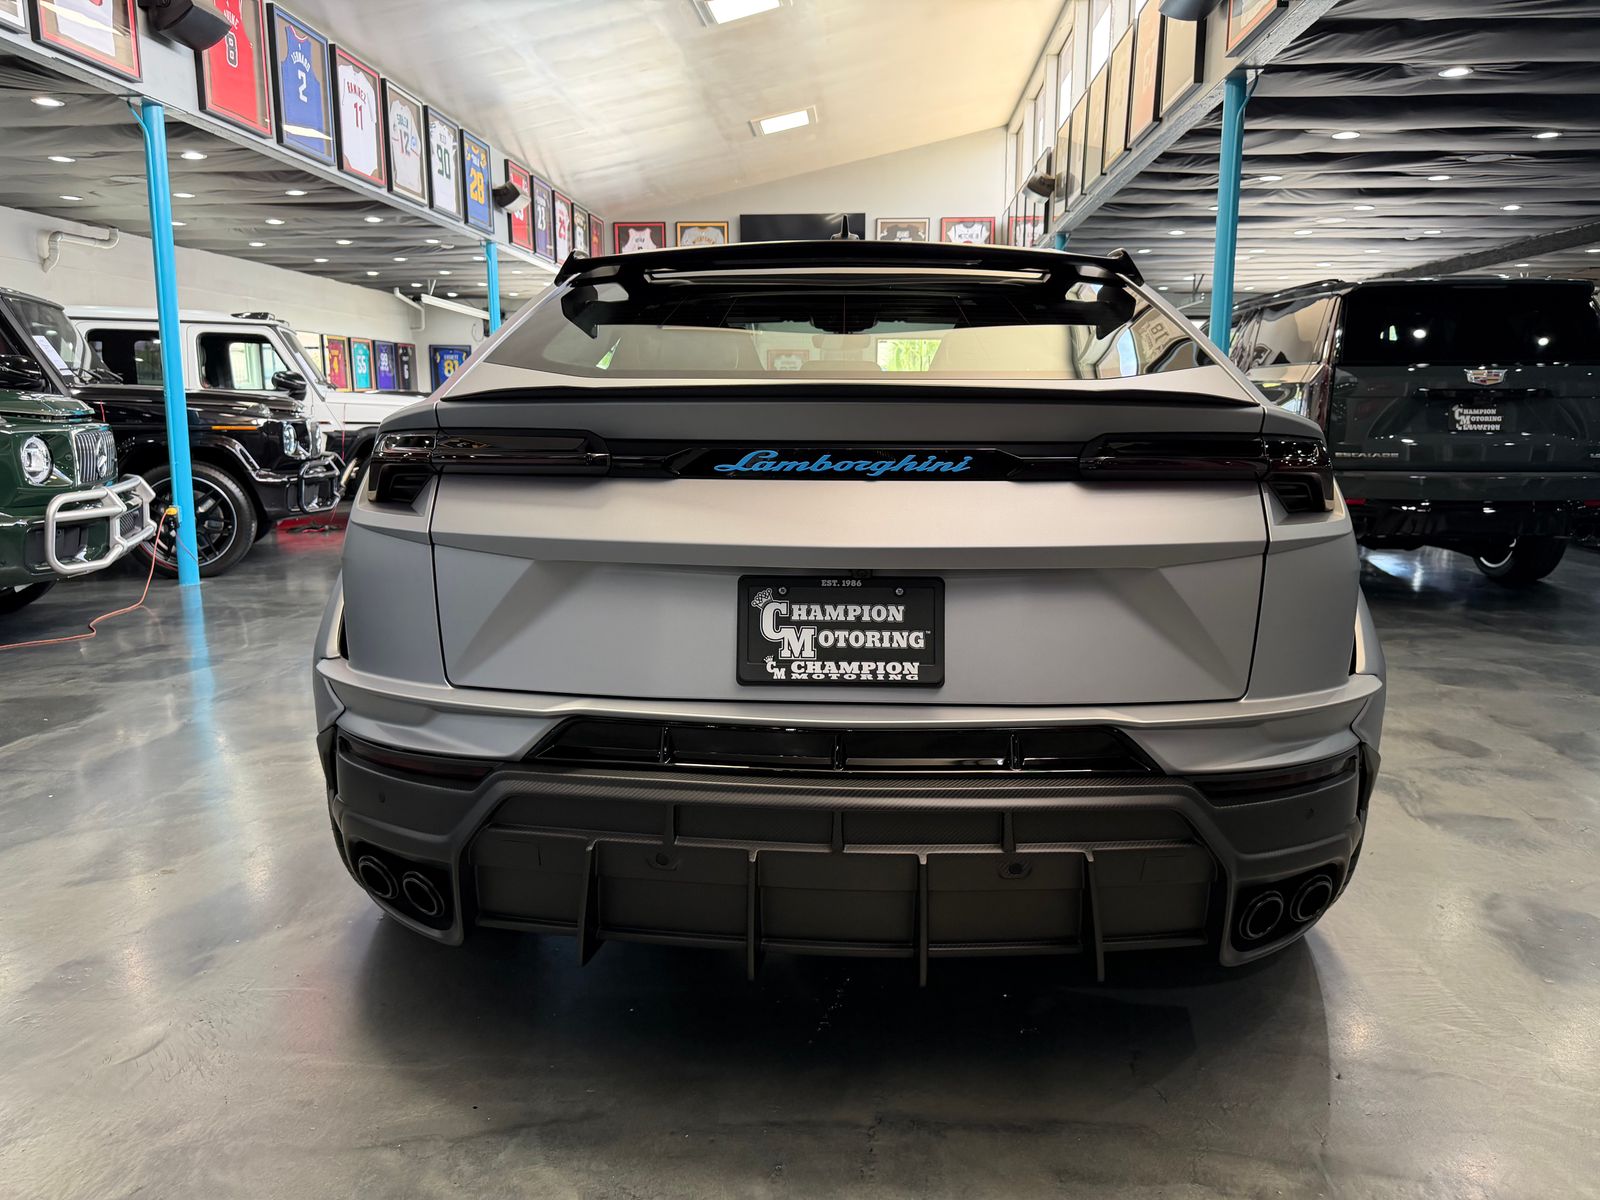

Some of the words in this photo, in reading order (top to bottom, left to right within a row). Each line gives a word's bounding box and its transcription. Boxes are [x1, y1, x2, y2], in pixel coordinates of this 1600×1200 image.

[225, 31, 238, 68] 8
[290, 51, 311, 73] LEONARD
[297, 70, 308, 103] 2
[353, 101, 364, 131] 11
[436, 143, 451, 180] 90
[469, 167, 485, 205] 28
[356, 354, 367, 375] 55
[1460, 415, 1502, 424] MOTORING
[713, 450, 974, 477] Lamborghini
[821, 579, 840, 587] EST.
[842, 579, 862, 587] 1986
[778, 626, 926, 660] MOTORING
[791, 661, 920, 674] CHAMPION
